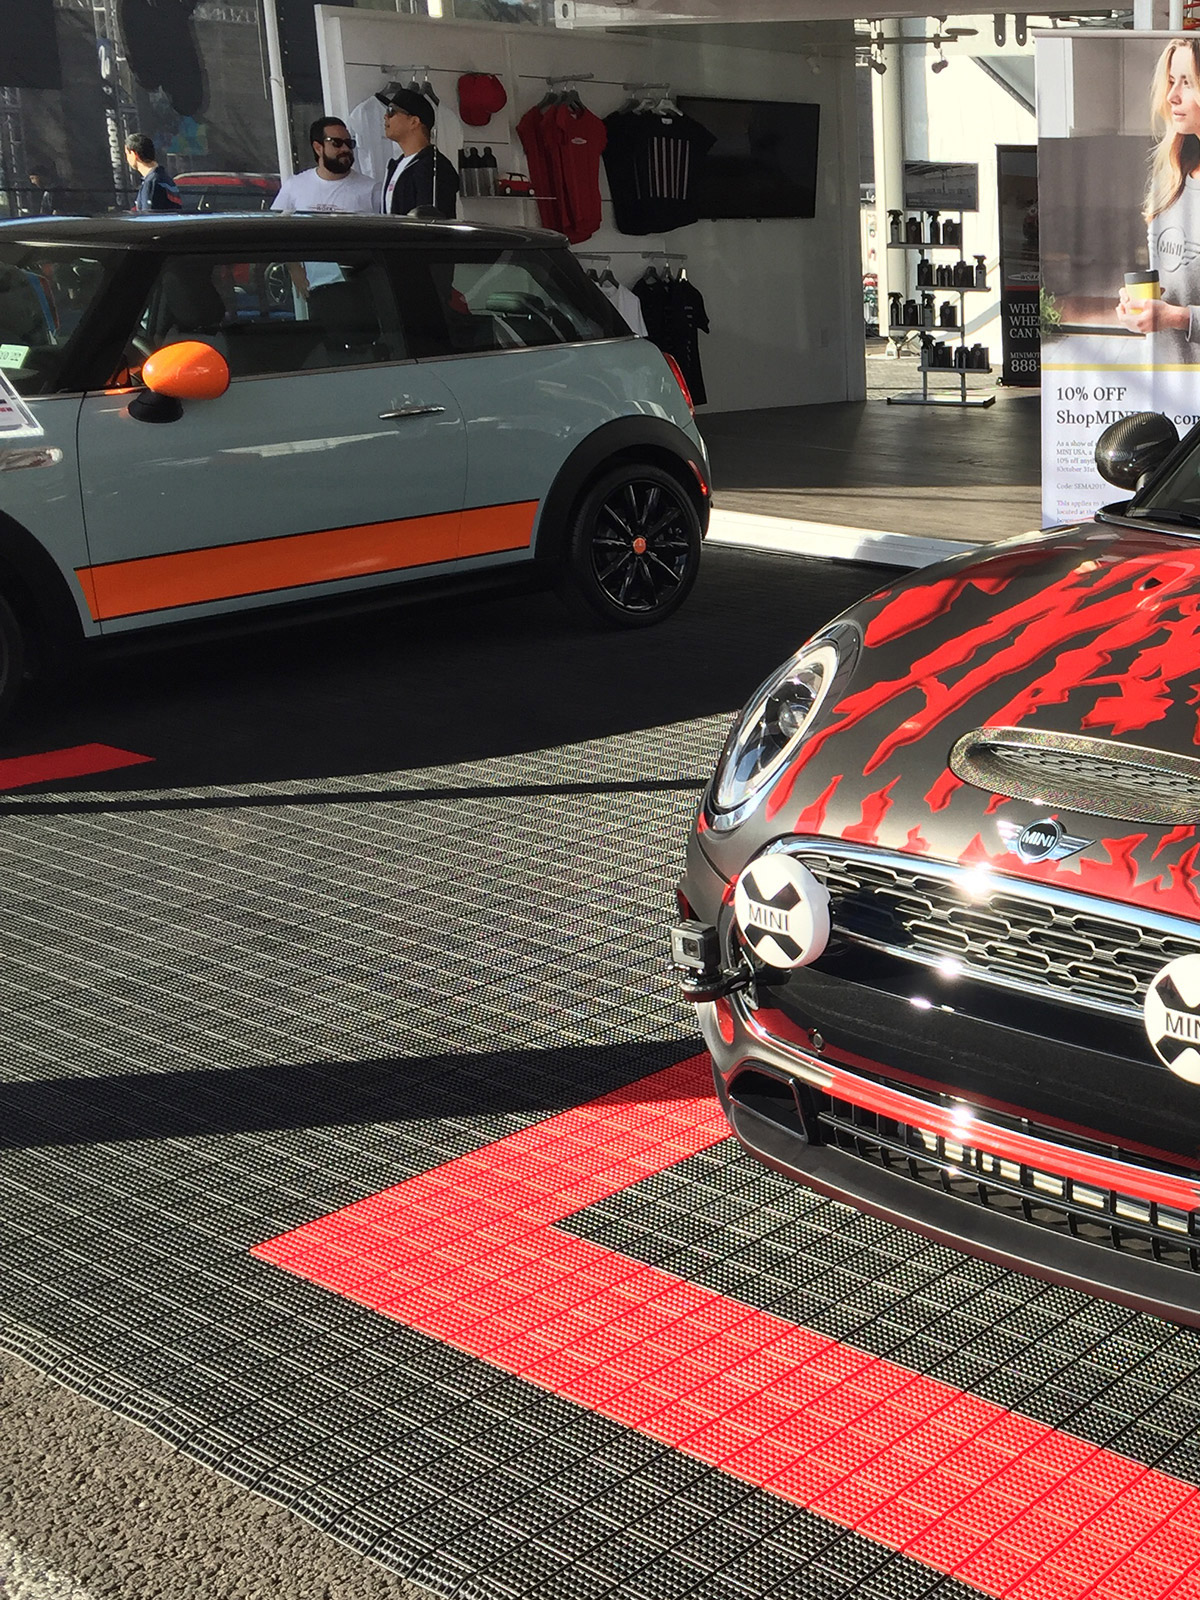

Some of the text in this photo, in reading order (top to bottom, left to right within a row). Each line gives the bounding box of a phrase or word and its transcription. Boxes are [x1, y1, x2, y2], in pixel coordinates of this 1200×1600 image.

[1160, 241, 1182, 257] MINI
[1009, 304, 1038, 314] WHY
[1009, 328, 1033, 339] CAN
[1056, 387, 1127, 401] 10% OFF
[1022, 831, 1055, 848] MINI
[749, 903, 789, 932] MINI
